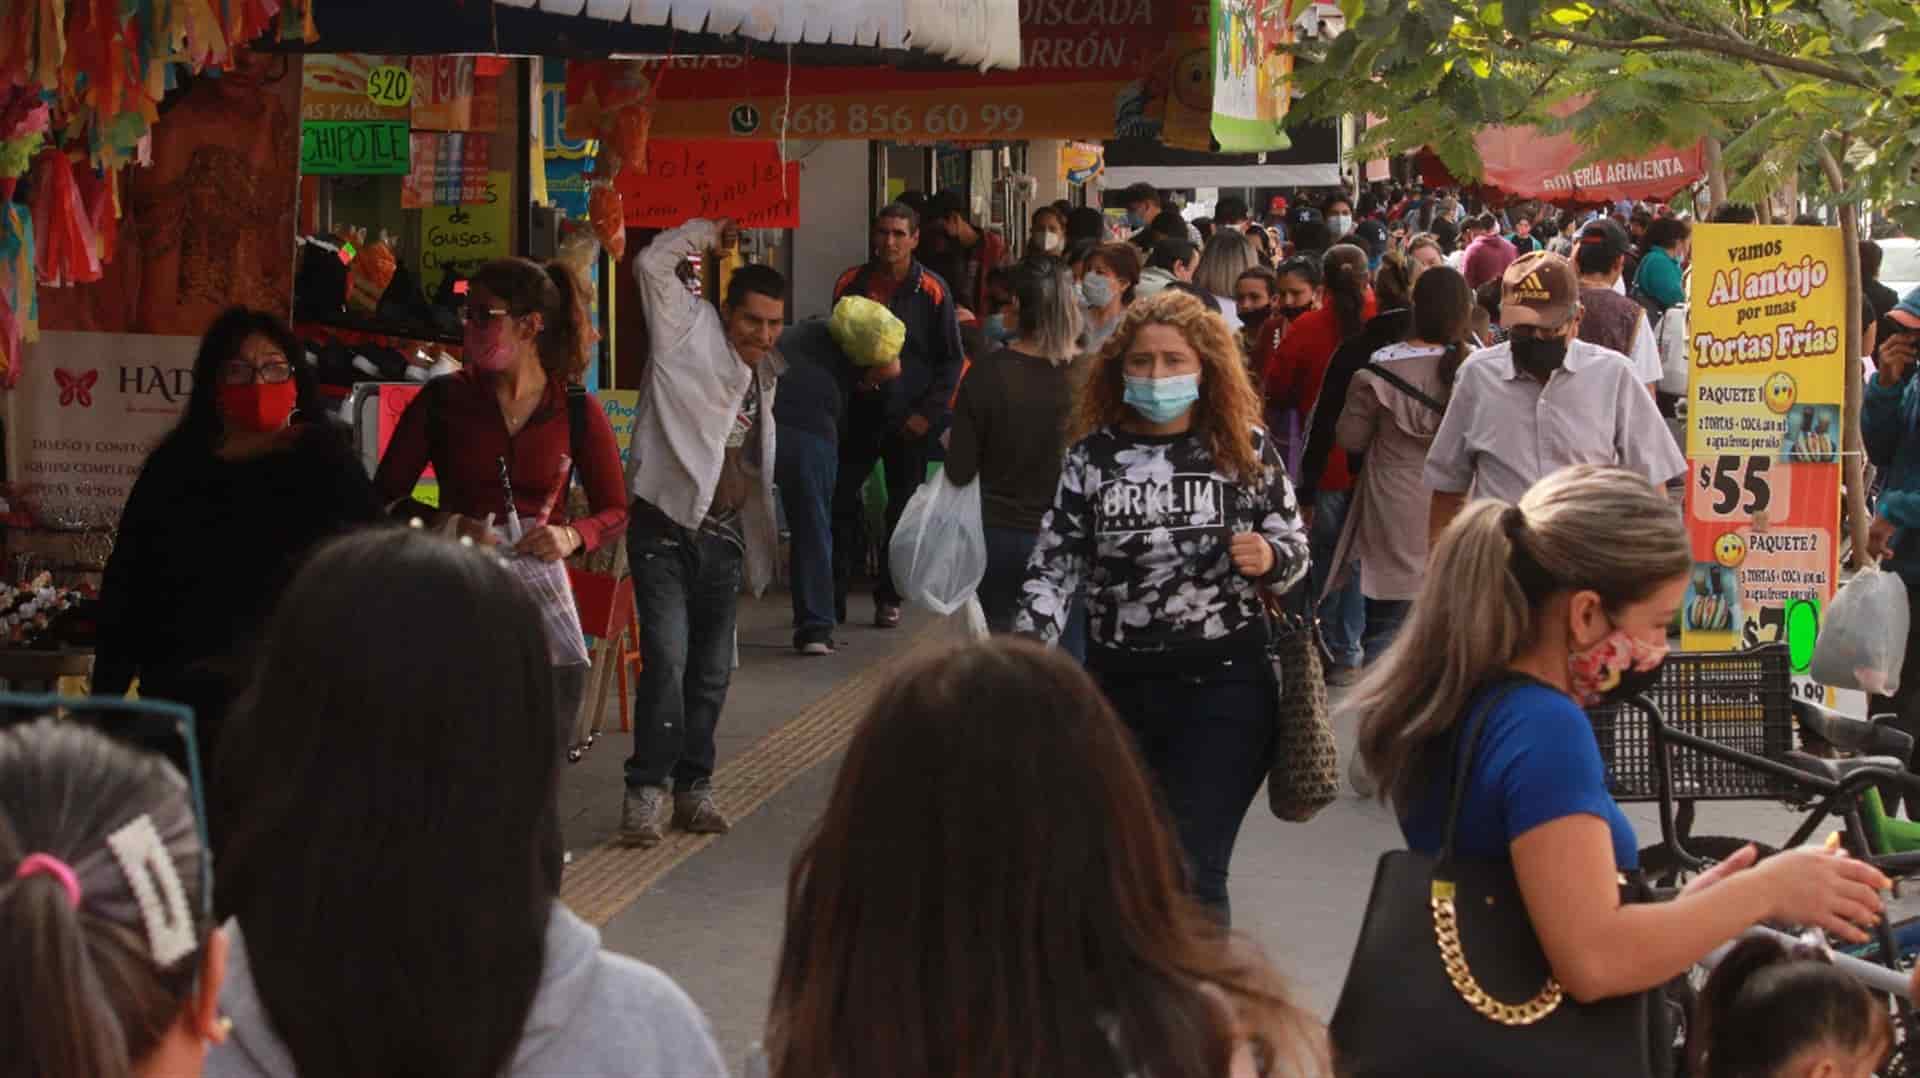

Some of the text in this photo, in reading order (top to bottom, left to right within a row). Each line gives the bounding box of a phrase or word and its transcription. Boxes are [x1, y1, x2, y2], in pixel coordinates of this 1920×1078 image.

[1020, 30, 1128, 69] RRÓN
[370, 70, 407, 100] $20
[771, 102, 1024, 135] 668 856 60 99
[302, 125, 405, 162] CHIPOTLE
[1607, 156, 1684, 183] ARMENTA
[448, 207, 472, 224] de
[1728, 240, 1782, 263] vamos
[1708, 254, 1828, 308] Al antojo
[1737, 301, 1796, 324] por unas
[1694, 320, 1838, 368] Tortas Frías
[1699, 386, 1756, 404] PAQUETE
[1699, 455, 1771, 516] $55
[1750, 534, 1818, 553] PAQUETE 2
